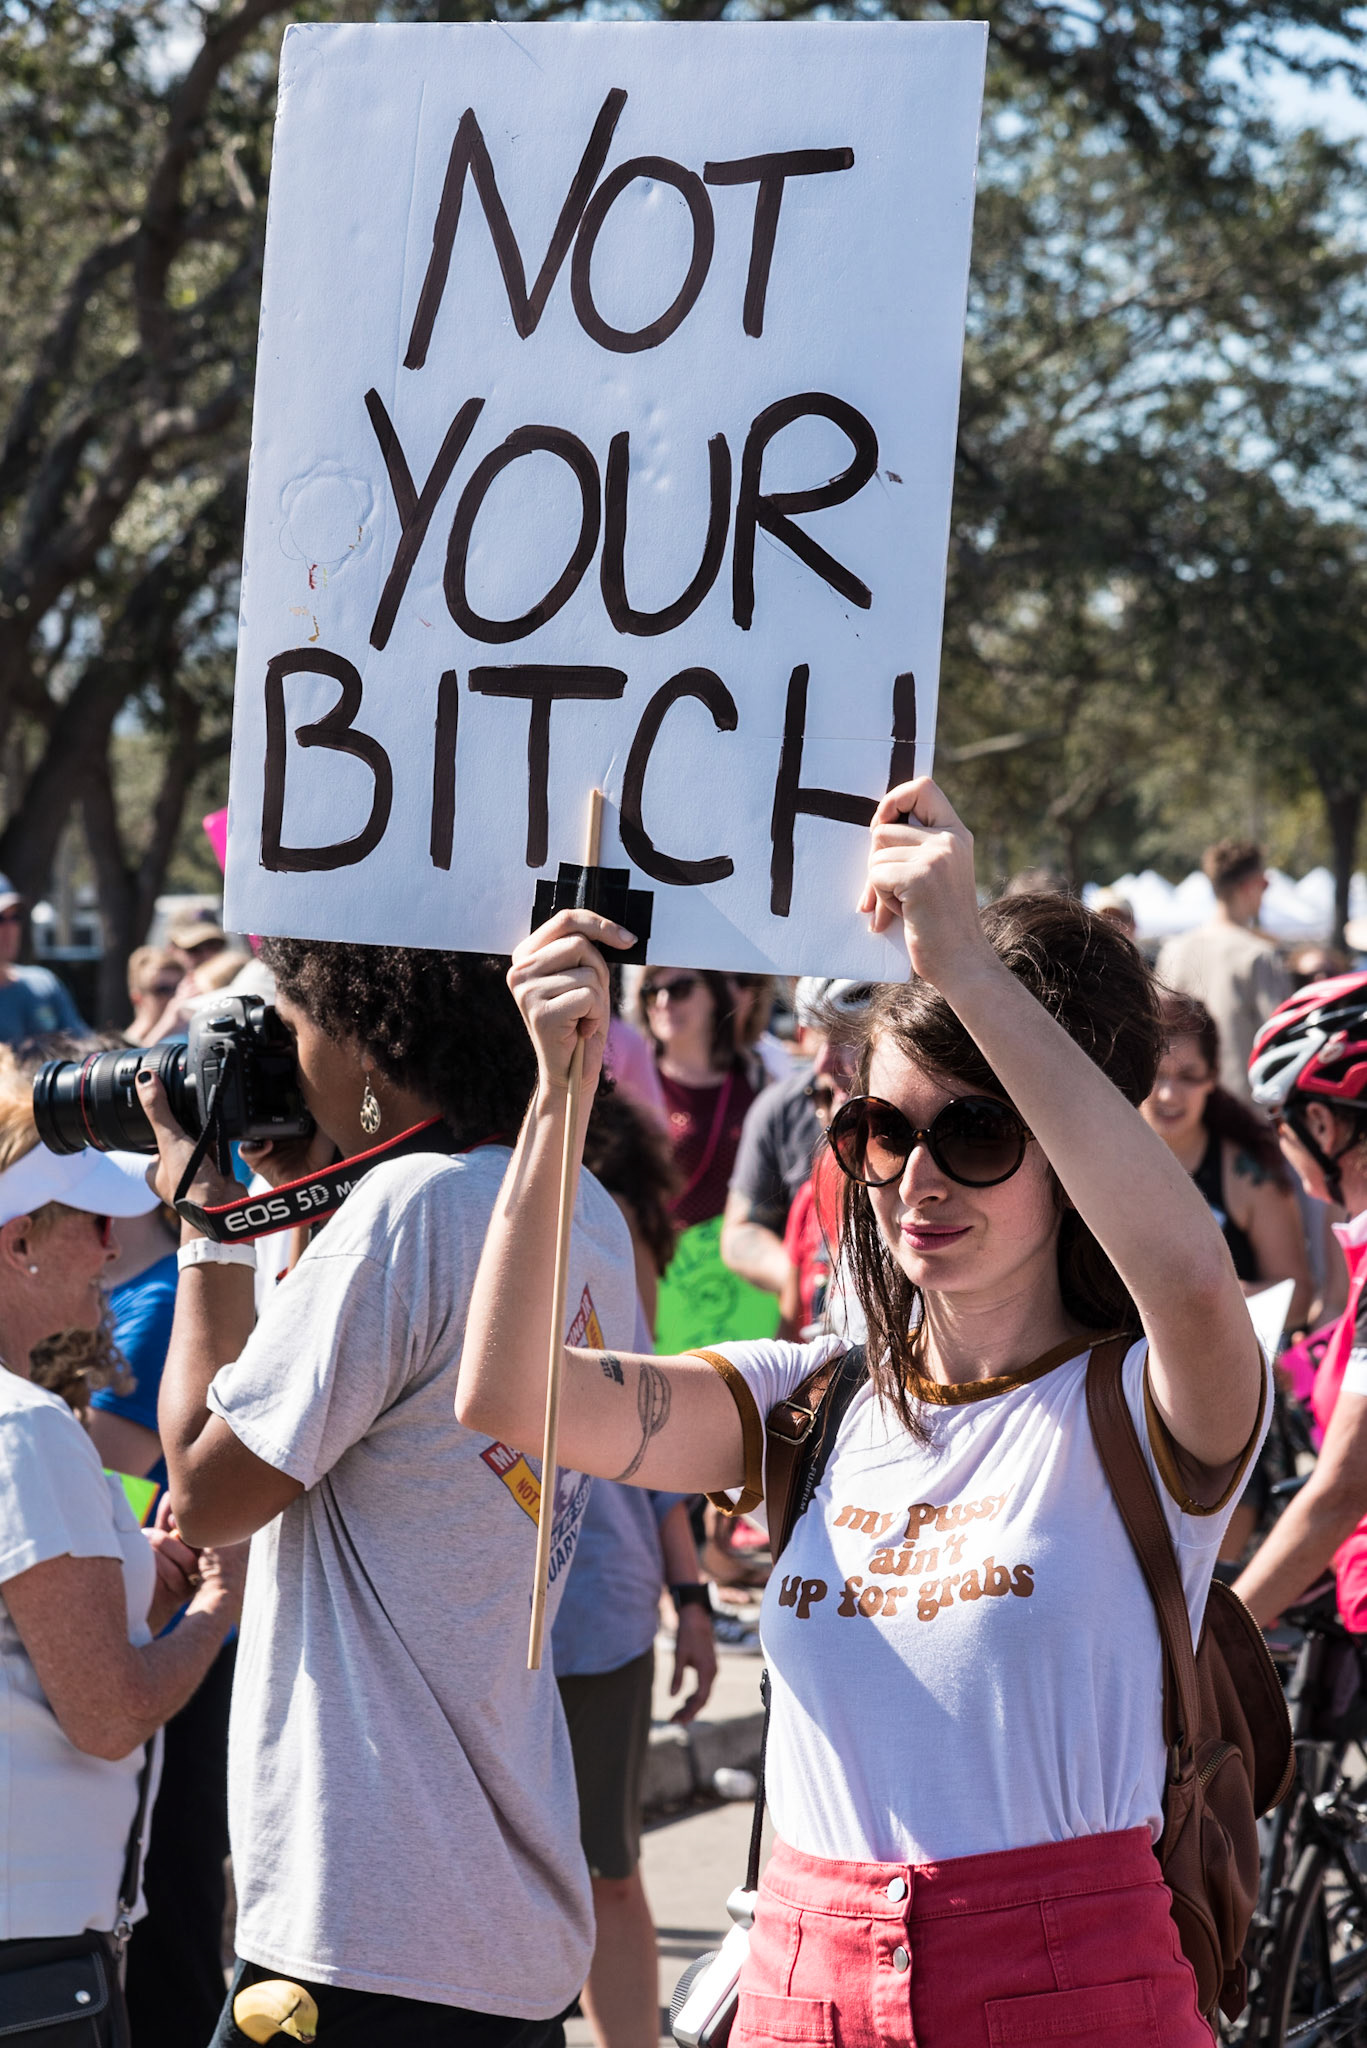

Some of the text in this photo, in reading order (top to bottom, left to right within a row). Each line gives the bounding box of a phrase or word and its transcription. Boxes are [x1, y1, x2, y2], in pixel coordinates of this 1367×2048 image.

[403, 88, 853, 370] NOT
[364, 387, 879, 651] YOUR
[260, 648, 917, 918] BITCH
[224, 1198, 291, 1232] EOS
[295, 1184, 330, 1211] 5D
[515, 1477, 541, 1507] NOT
[833, 1504, 901, 1540] my
[547, 1521, 578, 1588] UARY
[869, 1532, 968, 1576] ain't
[779, 1555, 1035, 1622] up for grabs
